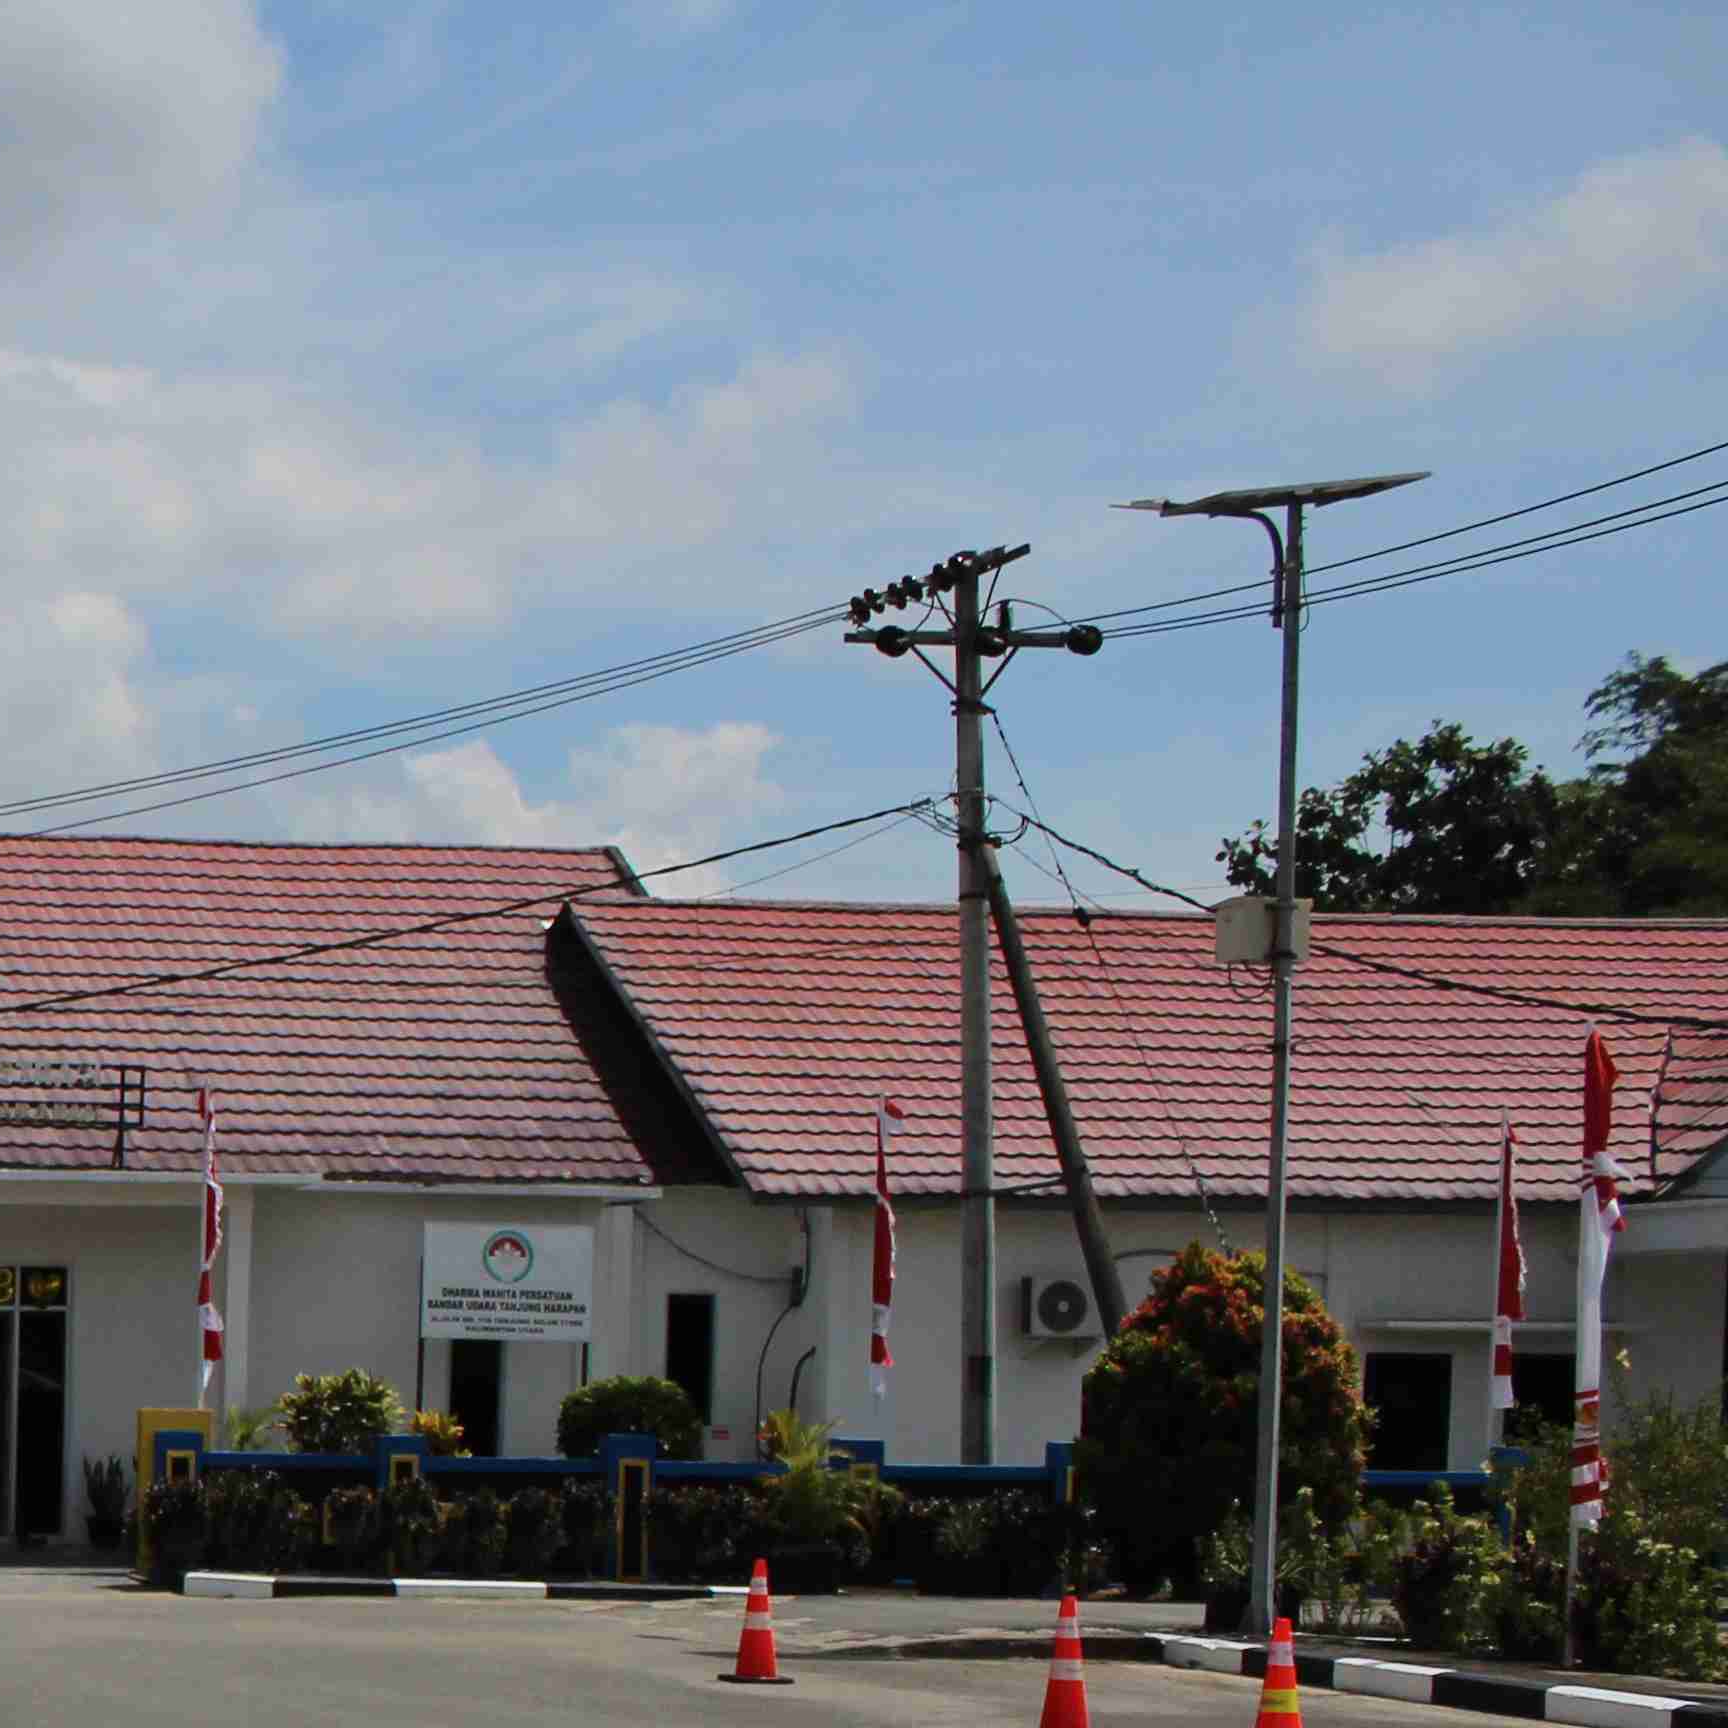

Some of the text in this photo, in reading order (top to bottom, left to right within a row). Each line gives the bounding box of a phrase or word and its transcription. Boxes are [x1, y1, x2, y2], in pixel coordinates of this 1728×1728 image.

[441, 1287, 480, 1297] DHARMA
[465, 1301, 497, 1311] UDARA
[499, 1302, 542, 1313] TANJUNG
[543, 1303, 587, 1314] HARAPAN
